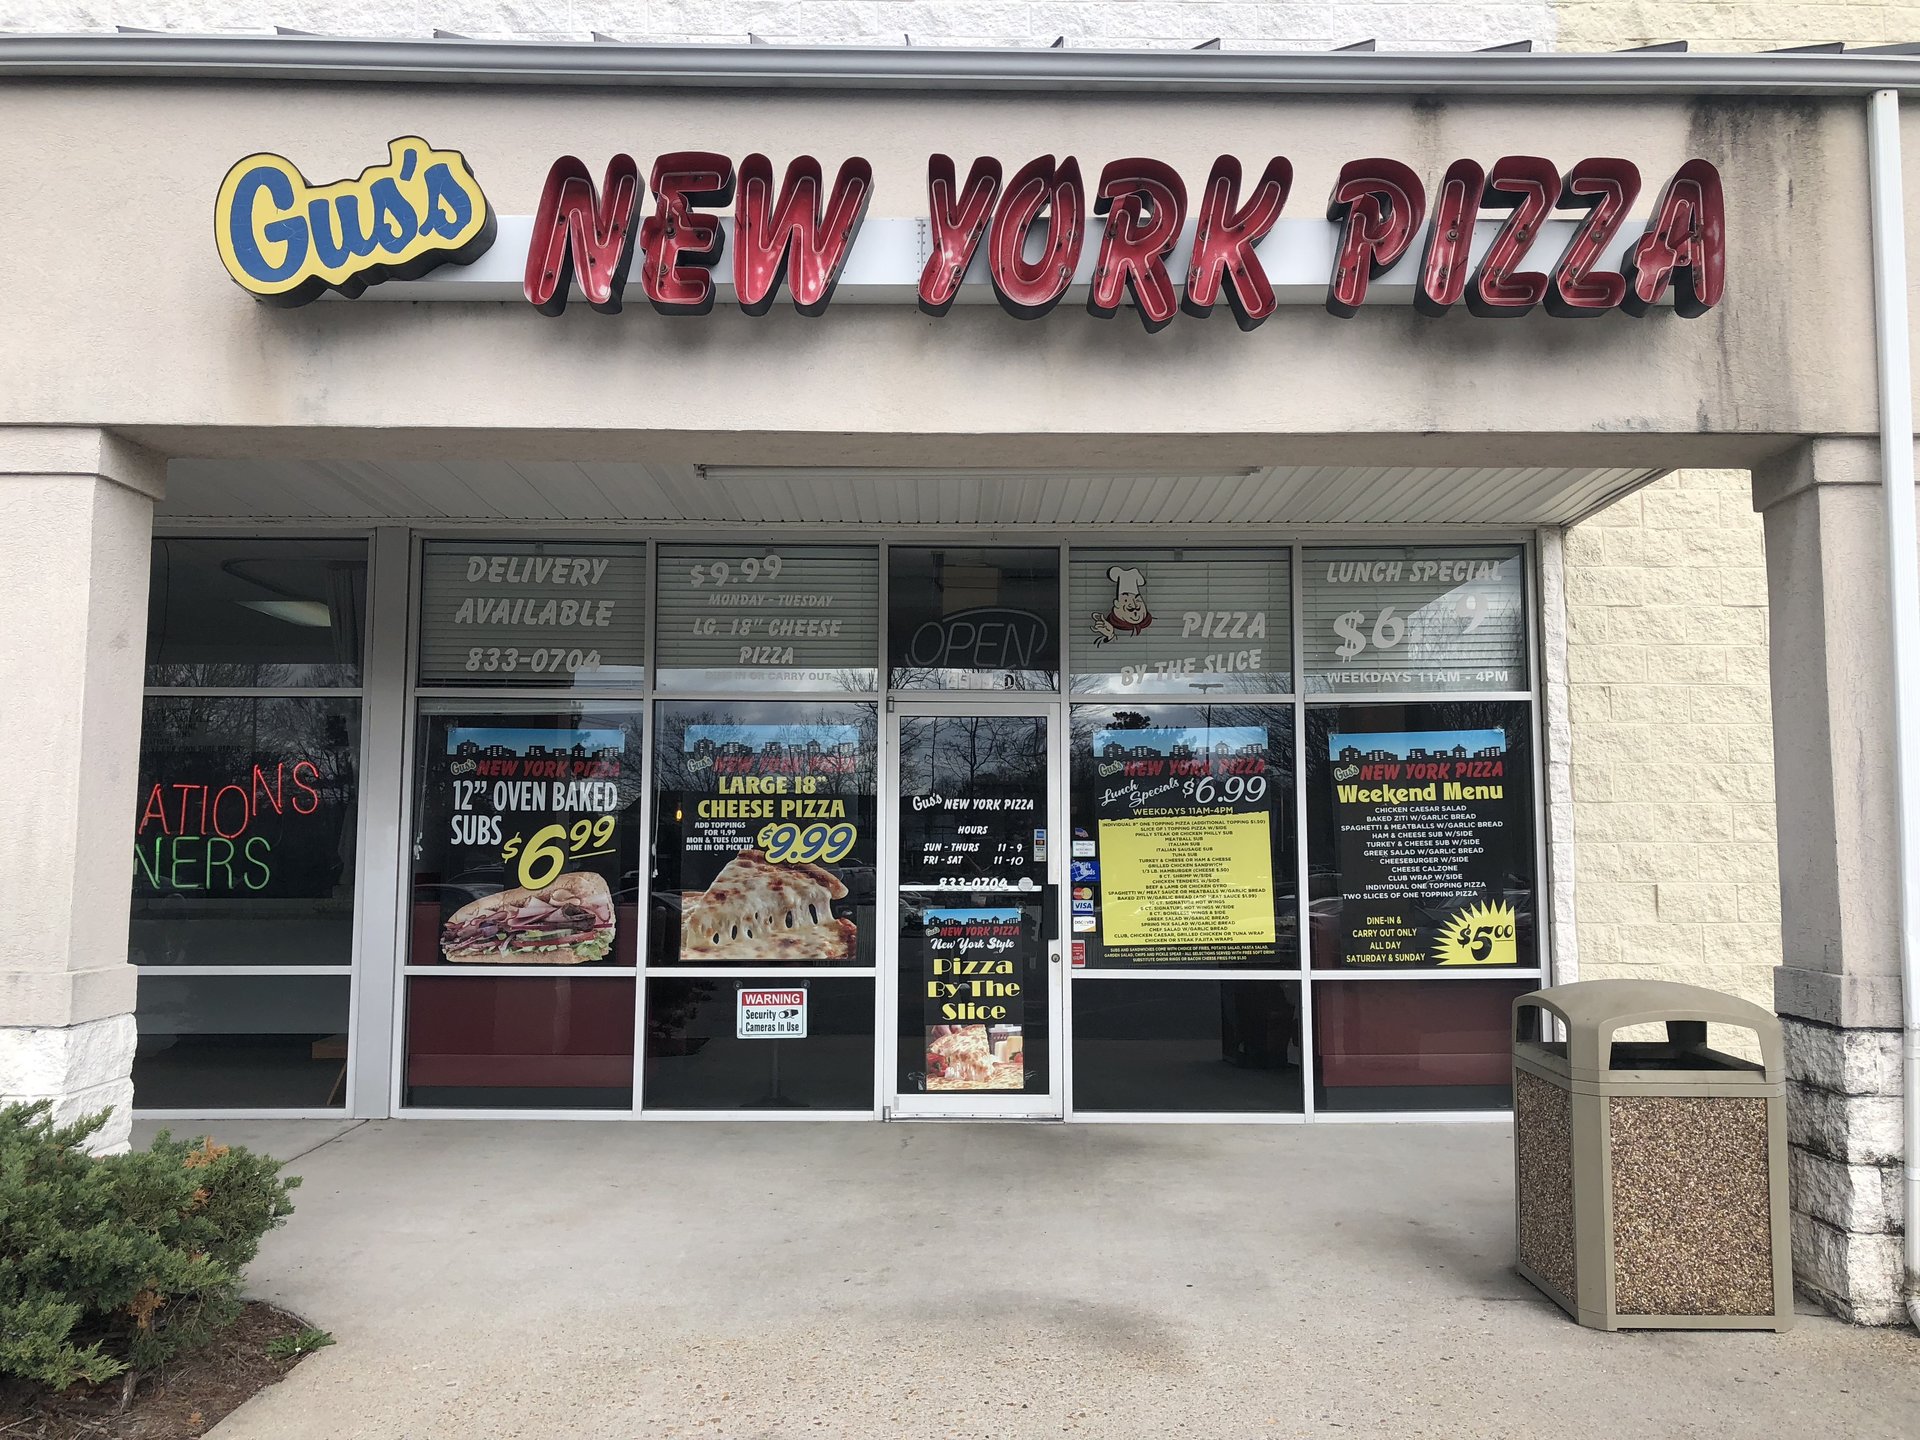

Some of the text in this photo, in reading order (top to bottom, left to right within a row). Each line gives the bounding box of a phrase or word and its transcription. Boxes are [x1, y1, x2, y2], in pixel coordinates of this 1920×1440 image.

[229, 147, 1727, 324] Gus's NEW YORK PIZZA
[466, 556, 609, 587] DELIVERY
[690, 555, 782, 588] $9.99
[1326, 560, 1503, 583] LUNCH SPECIAL
[708, 594, 765, 606] MONDAY
[778, 594, 834, 607] TUESDAY
[454, 598, 616, 627] AVAILABLE
[693, 618, 720, 636] LG.
[769, 618, 842, 637] CHEESE
[1181, 611, 1266, 639] PIZZA
[911, 621, 1037, 667] OPEN
[465, 647, 601, 673] 833-0704
[739, 646, 794, 664] PIZZA
[768, 671, 832, 681] CARRY OUT
[1120, 648, 1262, 686] BY THE SLICE
[1327, 671, 1412, 683] WEEKDAYS
[1417, 671, 1460, 682] 11AM
[1475, 671, 1509, 682] 4PM
[718, 776, 788, 795] LARGE
[1098, 779, 1139, 807] Lunch
[1128, 777, 1180, 808] Specials
[1182, 775, 1267, 804] $6.99
[1337, 782, 1503, 804] Weekend Menu
[493, 781, 546, 811] OVEN
[552, 782, 618, 812] BAKED
[912, 793, 1034, 811] Gus's NEW YORK PIZZA
[697, 799, 846, 819] CHEESE PIZZA
[1132, 806, 1234, 816] WEEKDAYS 11AM-4PM
[450, 815, 502, 846] SUBS
[957, 826, 988, 835] HOURS
[730, 836, 754, 844] (ONLY)
[760, 824, 856, 862] $9.99
[923, 843, 942, 852] SUN
[951, 843, 980, 852] THURS
[997, 843, 1006, 852] 11
[1017, 843, 1022, 852] 9
[923, 855, 938, 864] FRI
[946, 855, 963, 864] SAT
[993, 856, 1002, 864] 11
[938, 877, 1009, 890] 833-0704
[1367, 916, 1401, 925] DINE-IN &
[1353, 928, 1417, 937] CARRY OUT ONLY
[930, 937, 1014, 954] New York Style
[1370, 942, 1384, 950] ALL
[933, 957, 1013, 975] Pizza
[1346, 954, 1386, 962] SATURDAY
[1395, 953, 1425, 962] SUNDAY
[927, 980, 1020, 998] By The
[745, 993, 800, 1005] WARNING
[745, 1009, 777, 1021] Security
[942, 1002, 1007, 1021] Slice
[745, 1022, 800, 1032] Cameras In Use
